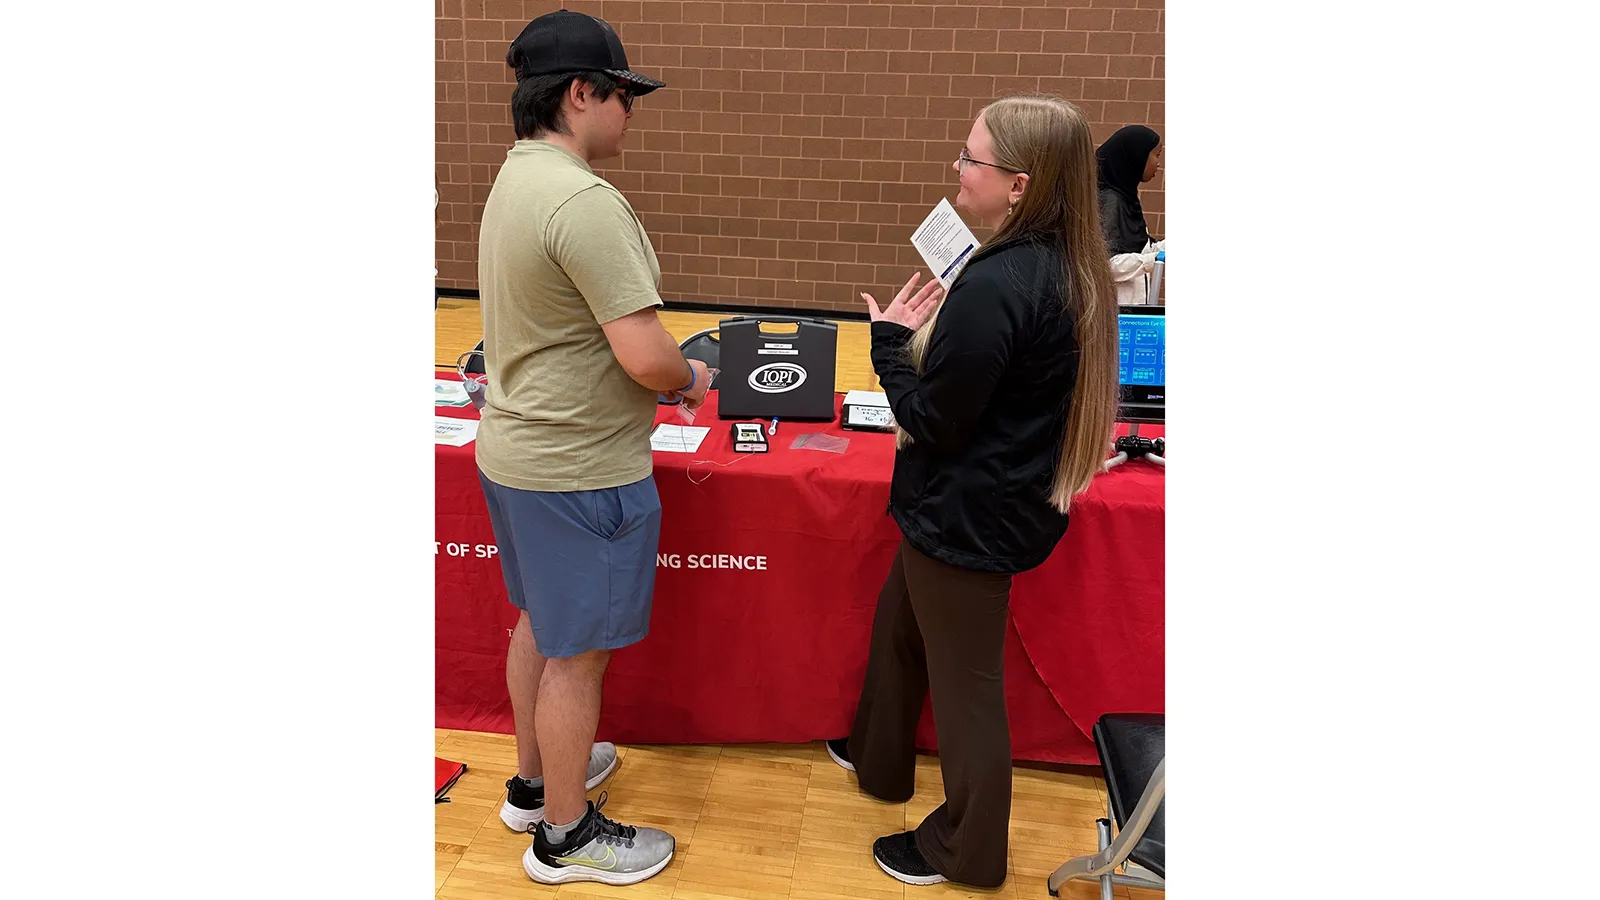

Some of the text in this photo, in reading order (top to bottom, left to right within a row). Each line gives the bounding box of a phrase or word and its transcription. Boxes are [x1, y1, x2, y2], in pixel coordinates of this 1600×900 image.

[761, 370, 794, 383] IOPI
[446, 542, 470, 557] OF
[687, 554, 767, 570] SCIENCE
